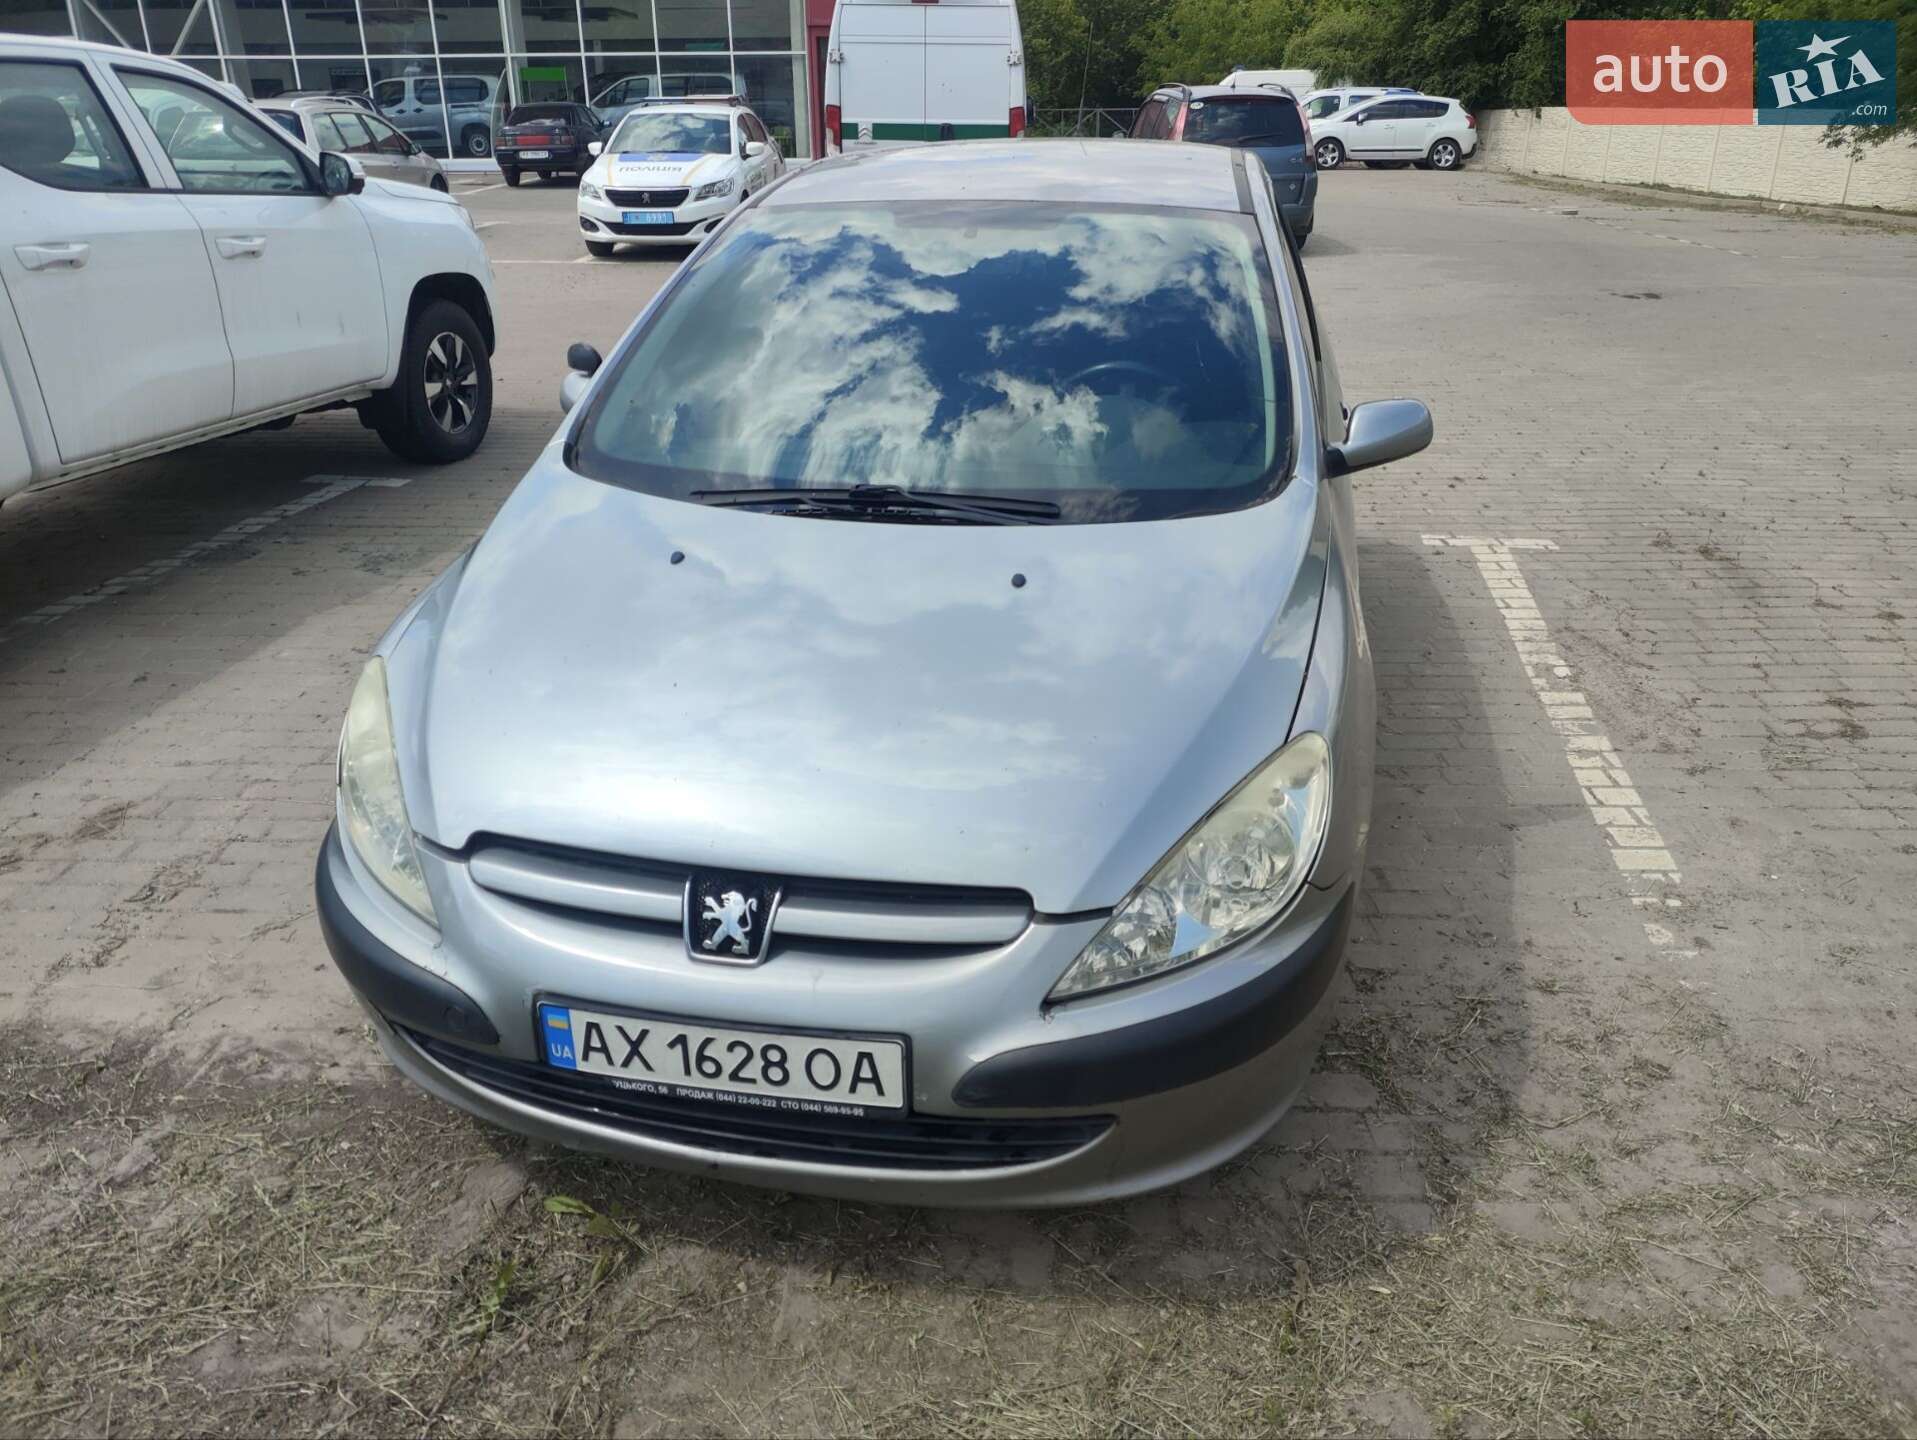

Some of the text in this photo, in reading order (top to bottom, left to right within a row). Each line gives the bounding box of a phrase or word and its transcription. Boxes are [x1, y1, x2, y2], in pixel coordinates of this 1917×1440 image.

[551, 1042, 573, 1061] UA
[581, 1021, 885, 1097] AX 1628 OA
[676, 1087, 714, 1101] ПРОДАЖ
[800, 1101, 822, 1113] (044)
